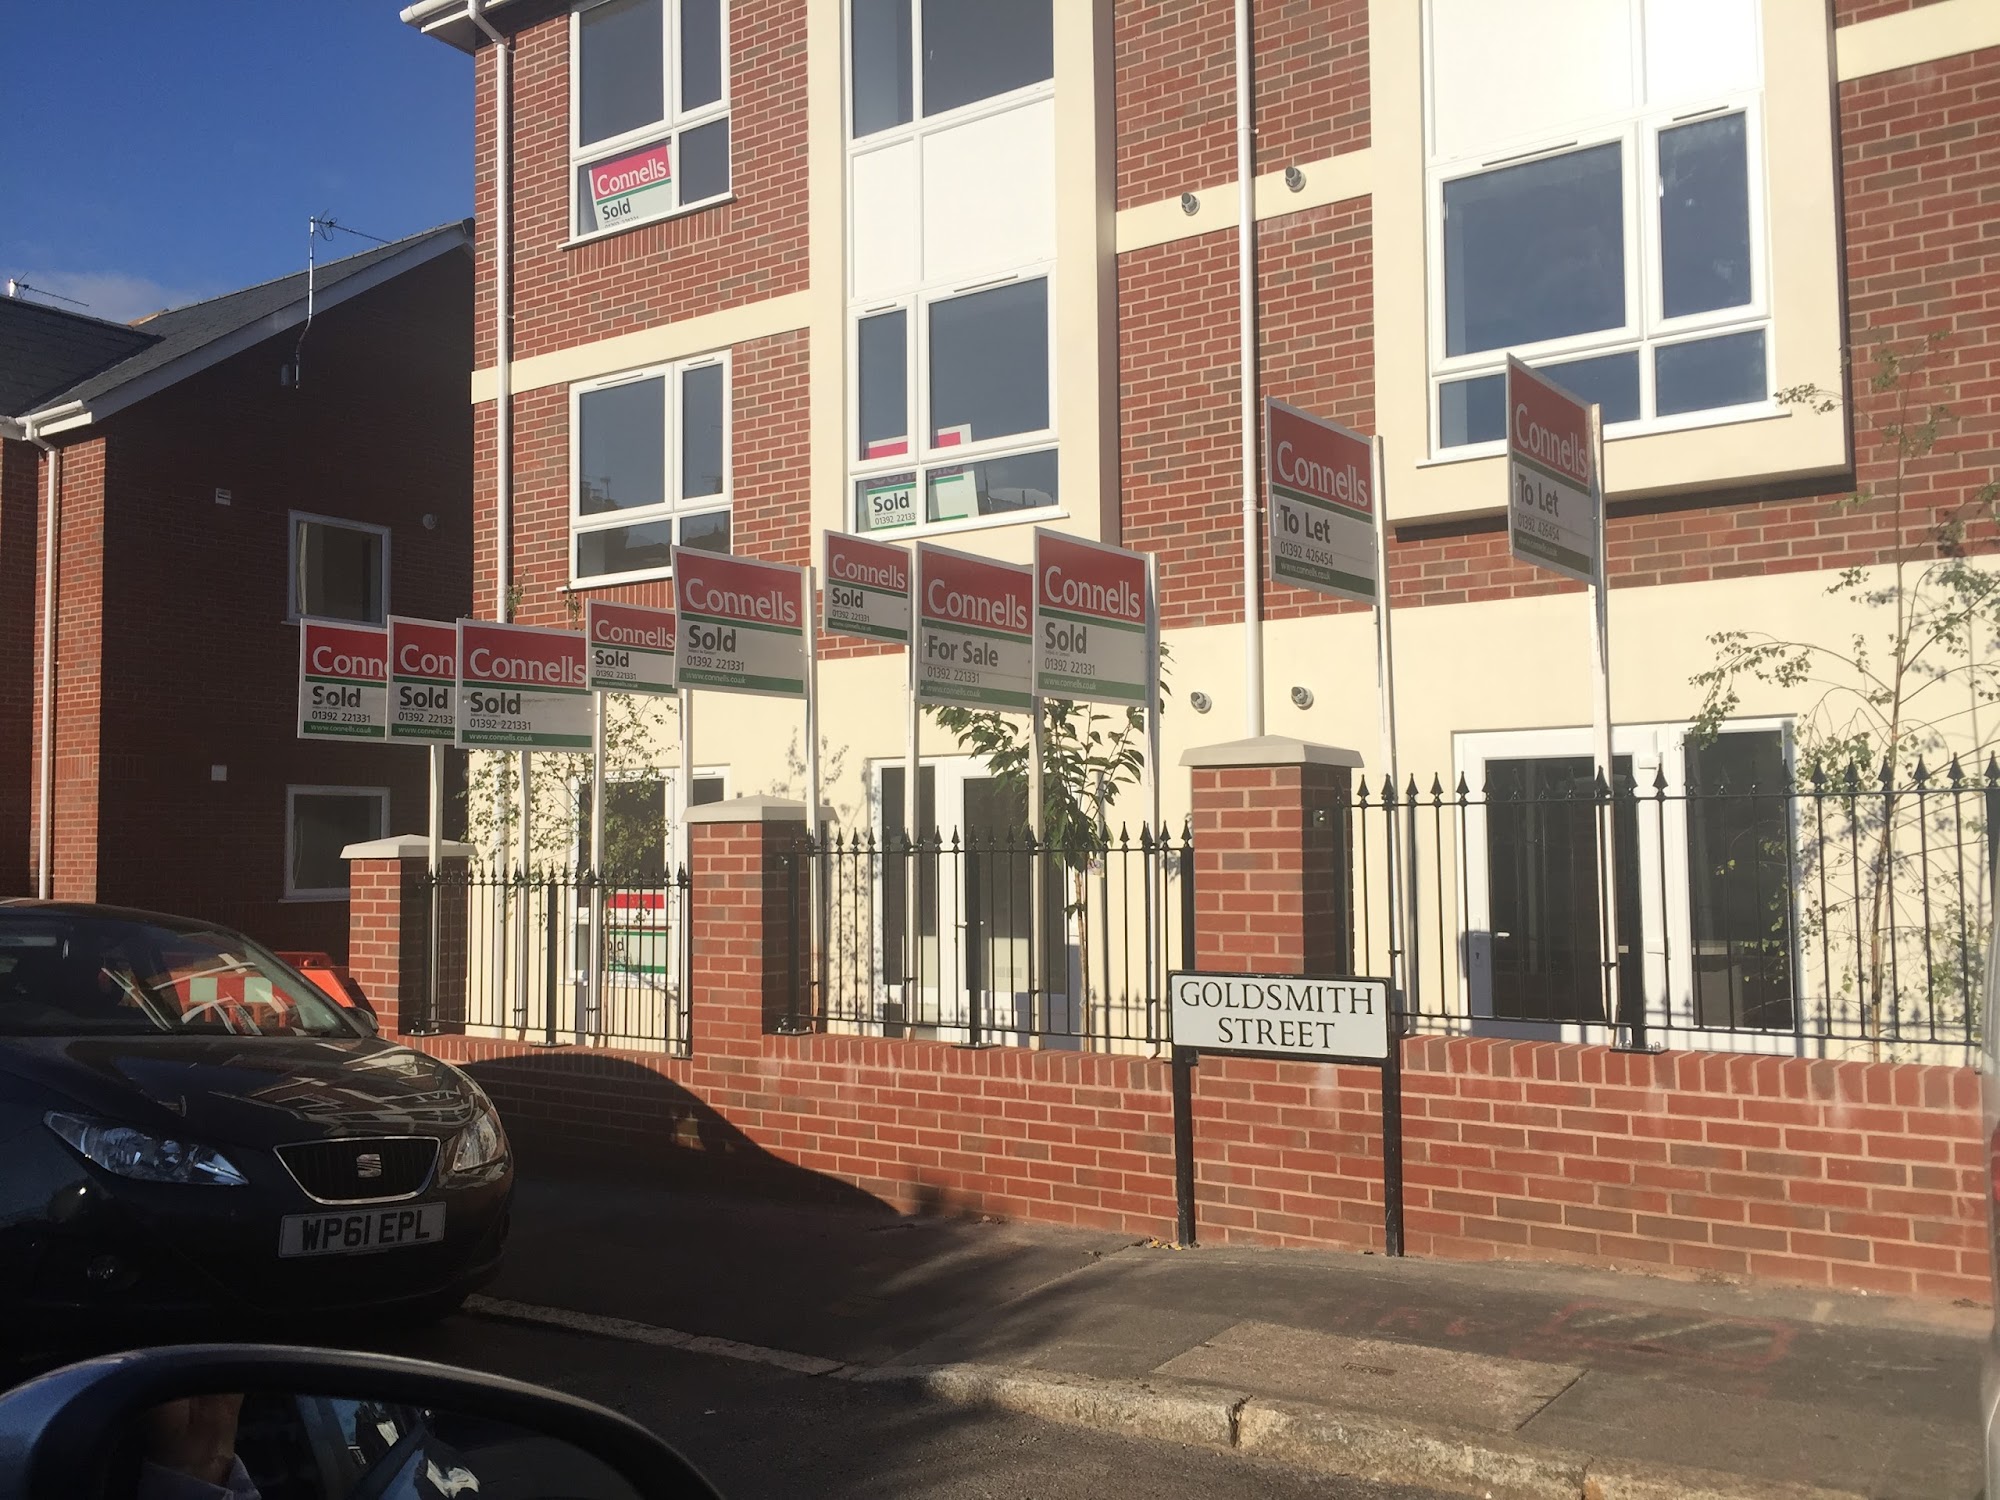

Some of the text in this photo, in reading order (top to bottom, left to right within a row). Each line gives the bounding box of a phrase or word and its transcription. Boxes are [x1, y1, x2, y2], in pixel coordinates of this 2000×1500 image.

[597, 158, 666, 195] Connells
[602, 198, 631, 220] Sold
[1516, 403, 1587, 478] Connells
[1276, 440, 1368, 507] Connells
[873, 491, 909, 512] Sold
[1519, 473, 1559, 517] To Let
[875, 516, 894, 525] 01392
[897, 513, 916, 522] 22133
[1280, 504, 1330, 544] To Let
[1280, 541, 1333, 566] 01392 426454
[832, 553, 906, 590] Connells
[686, 578, 797, 623] Connells
[832, 588, 863, 608] Sold
[928, 578, 1027, 630] Connells
[1045, 565, 1141, 618] Connells
[832, 610, 870, 622] 01392 221331
[596, 620, 675, 648] Connells
[688, 625, 736, 652] Sold
[1045, 622, 1087, 654] Sold
[312, 646, 387, 677] Conn
[400, 644, 456, 675] Con
[595, 650, 629, 667] Sold
[687, 655, 744, 671] 01392 221331
[929, 635, 998, 667] For Sale
[470, 648, 586, 684] Connells
[596, 670, 636, 680] 01392 221331
[928, 666, 979, 683] 01392 221331
[1045, 657, 1095, 675] 01392 221331
[312, 686, 361, 707] Sold
[400, 686, 448, 709] Sold
[470, 692, 521, 714] Sold
[312, 711, 370, 723] 01392 221331
[398, 712, 455, 724] 01392 22133
[470, 718, 531, 730] 01392 221331
[1180, 981, 1374, 1015] GOLDSMITH
[1218, 1017, 1335, 1048] STREET
[302, 1210, 430, 1251] WP61 EPL
